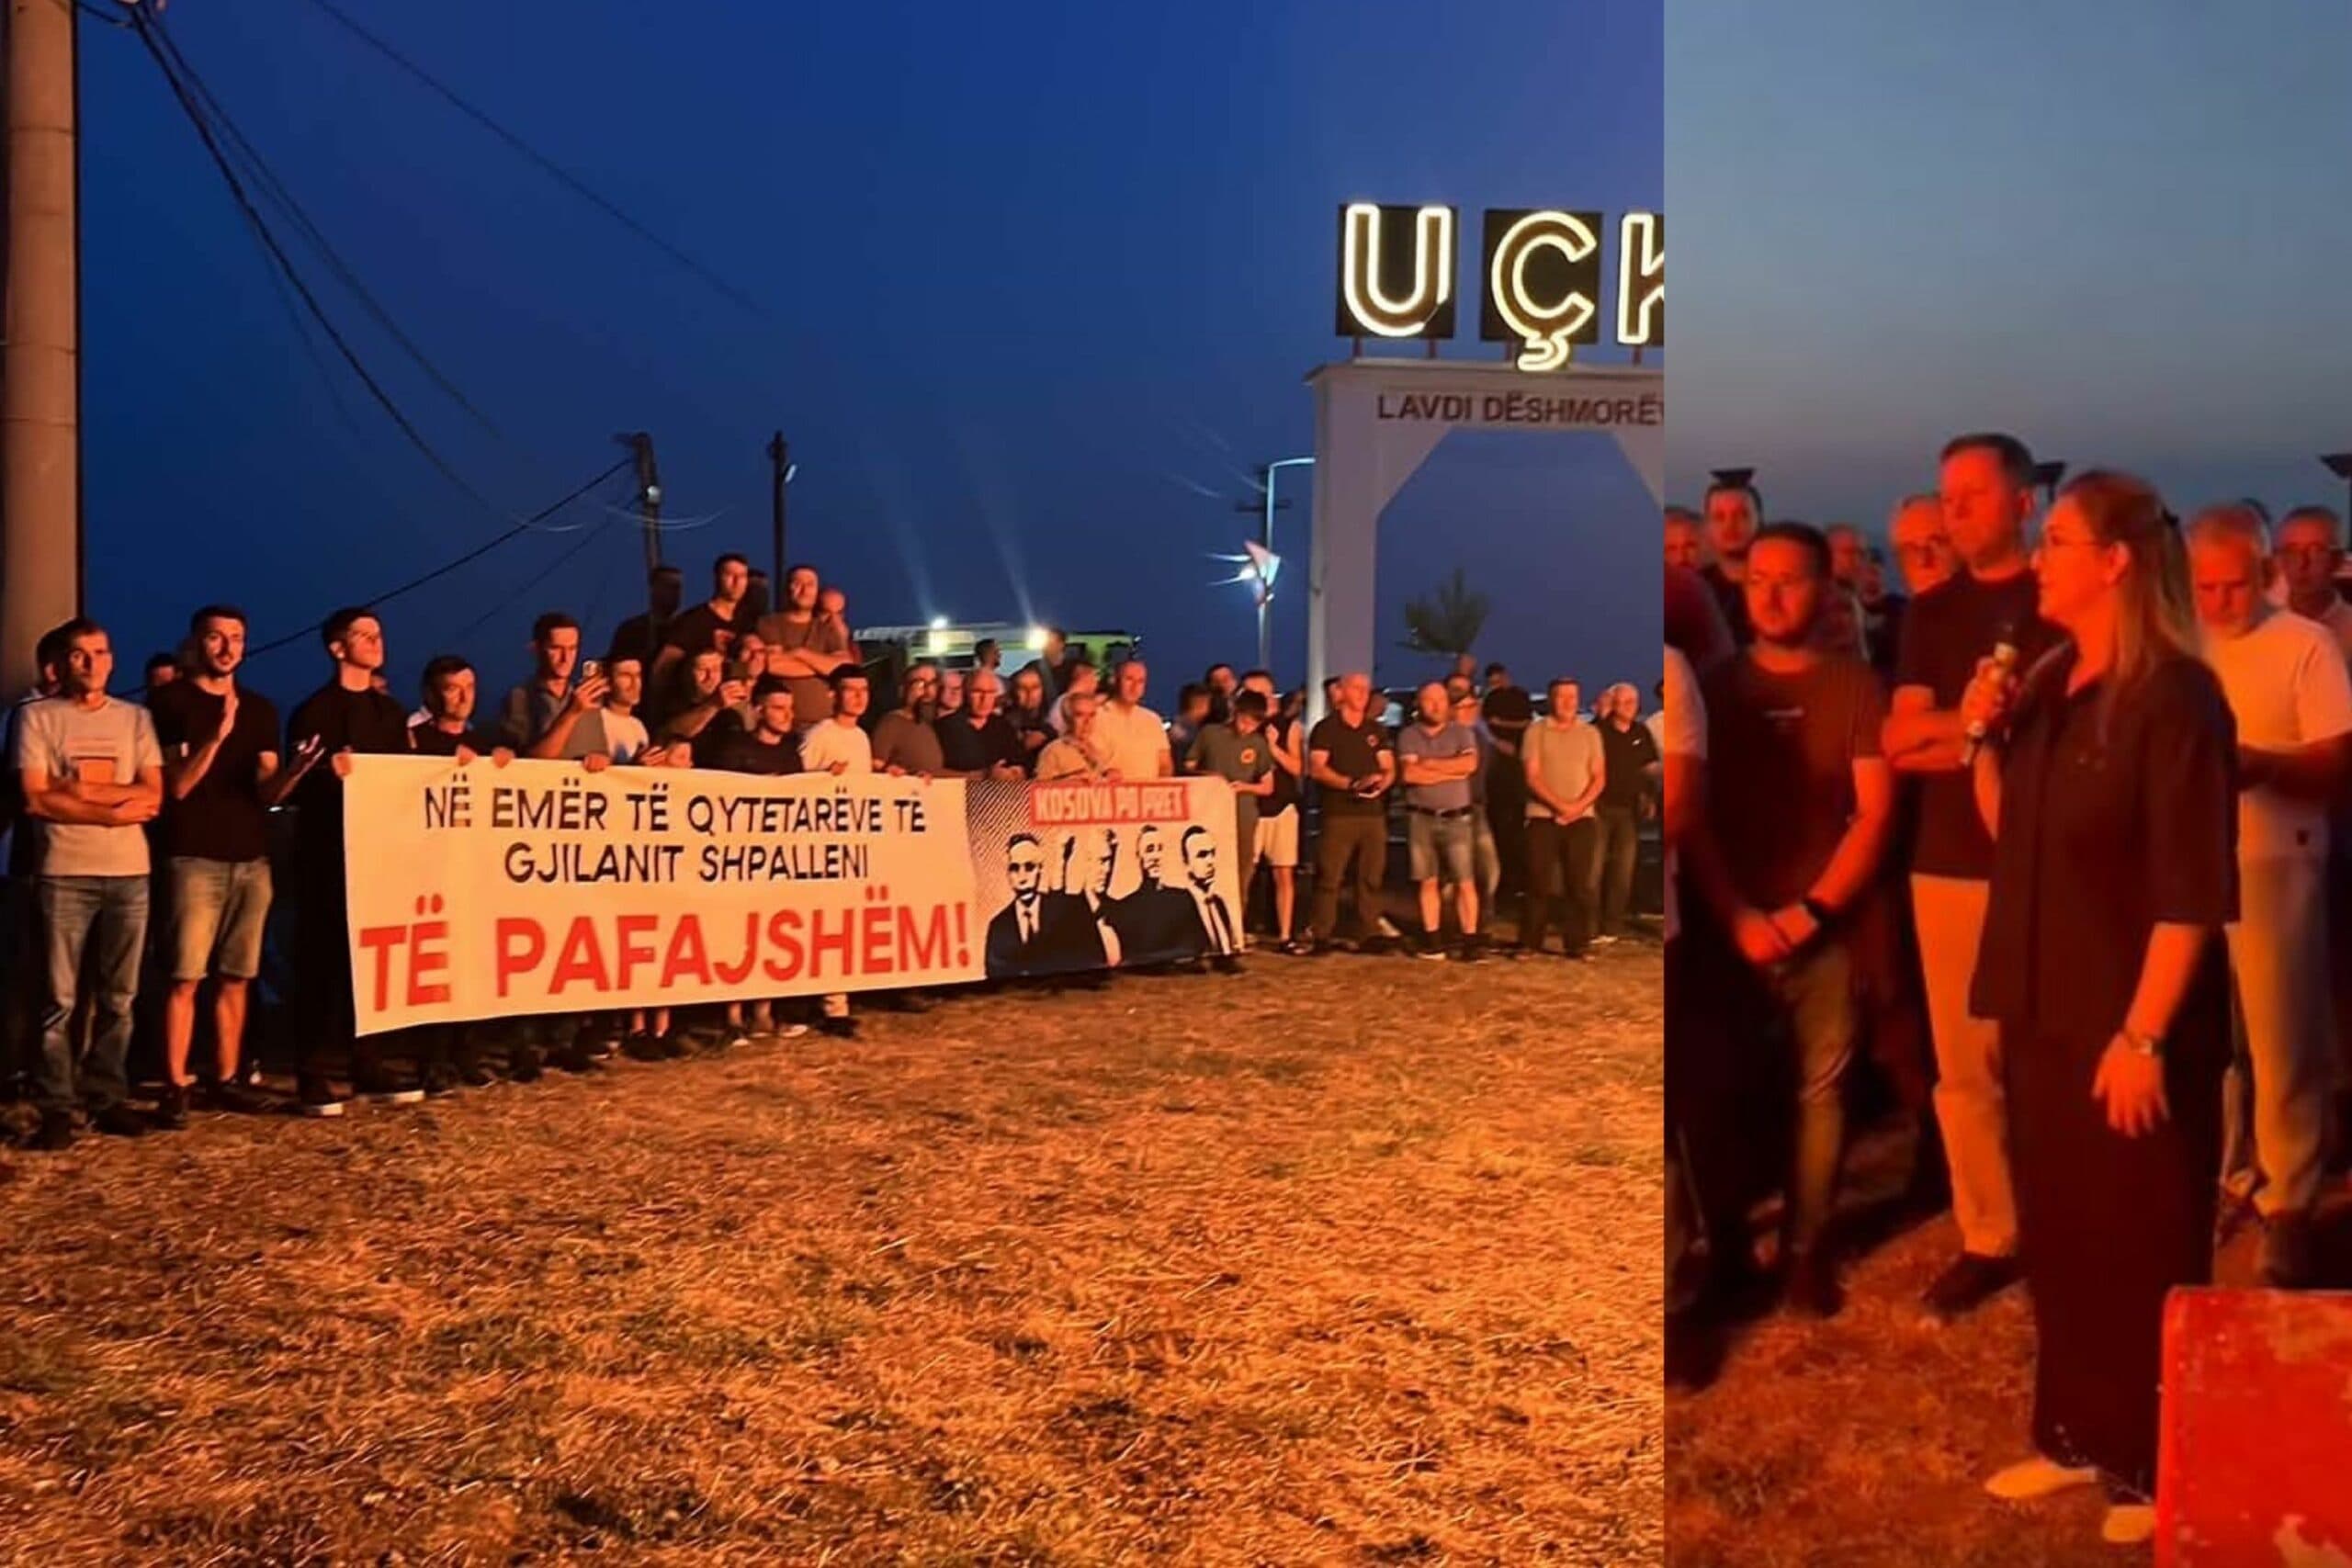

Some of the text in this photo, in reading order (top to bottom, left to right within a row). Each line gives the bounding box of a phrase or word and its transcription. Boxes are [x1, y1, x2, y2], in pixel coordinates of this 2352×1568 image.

[1378, 390, 1664, 426] LAVDI DËSHMORË
[424, 773, 927, 836] NË EMËR TË QYTETARËVE TË
[504, 841, 869, 884] GJILANIT SHPALLENI
[359, 885, 970, 1012] TË PAFAJSHËM!
